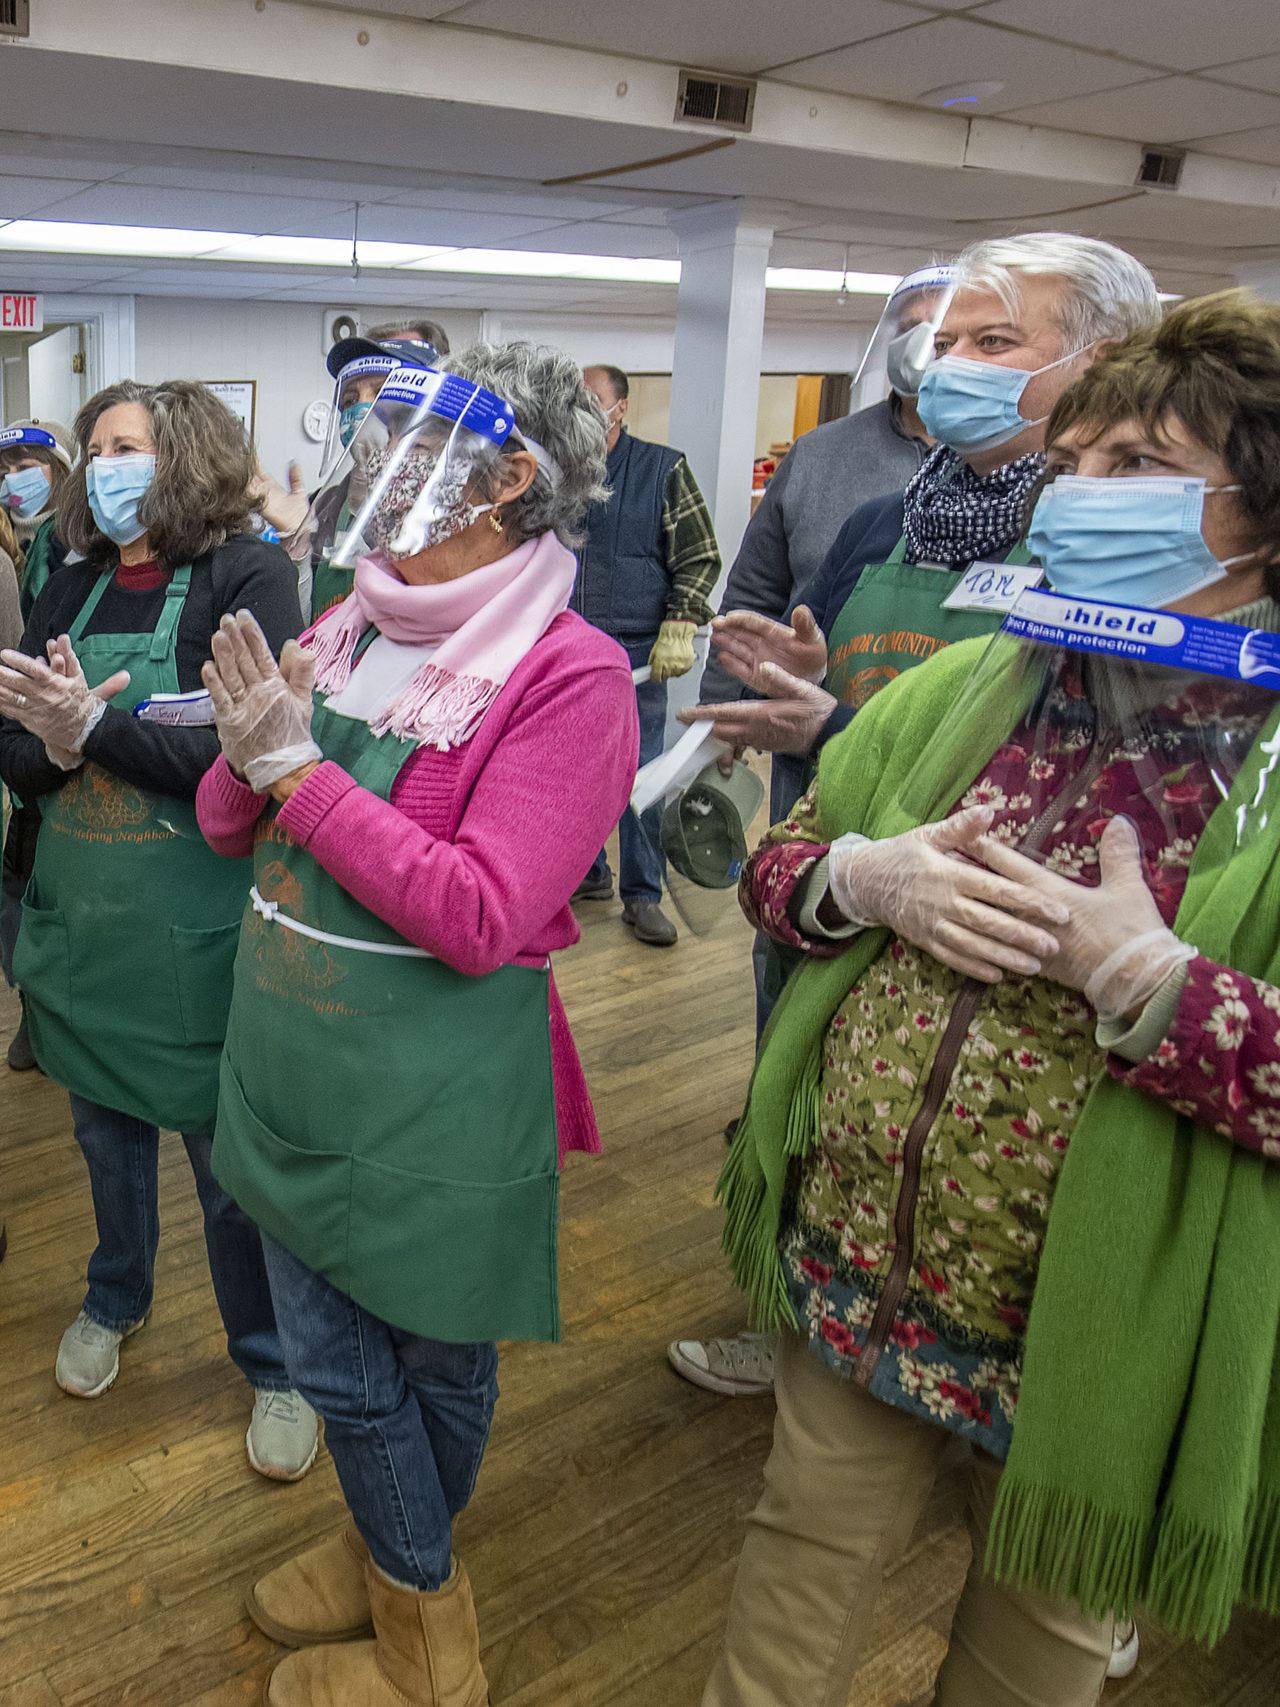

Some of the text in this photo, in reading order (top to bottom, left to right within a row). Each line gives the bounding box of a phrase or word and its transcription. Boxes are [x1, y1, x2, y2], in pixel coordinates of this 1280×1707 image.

[2, 295, 37, 327] EXIT
[1064, 606, 1158, 636] hield
[1026, 621, 1065, 641] Splash
[1067, 629, 1148, 656] protection
[74, 829, 114, 844] Helping
